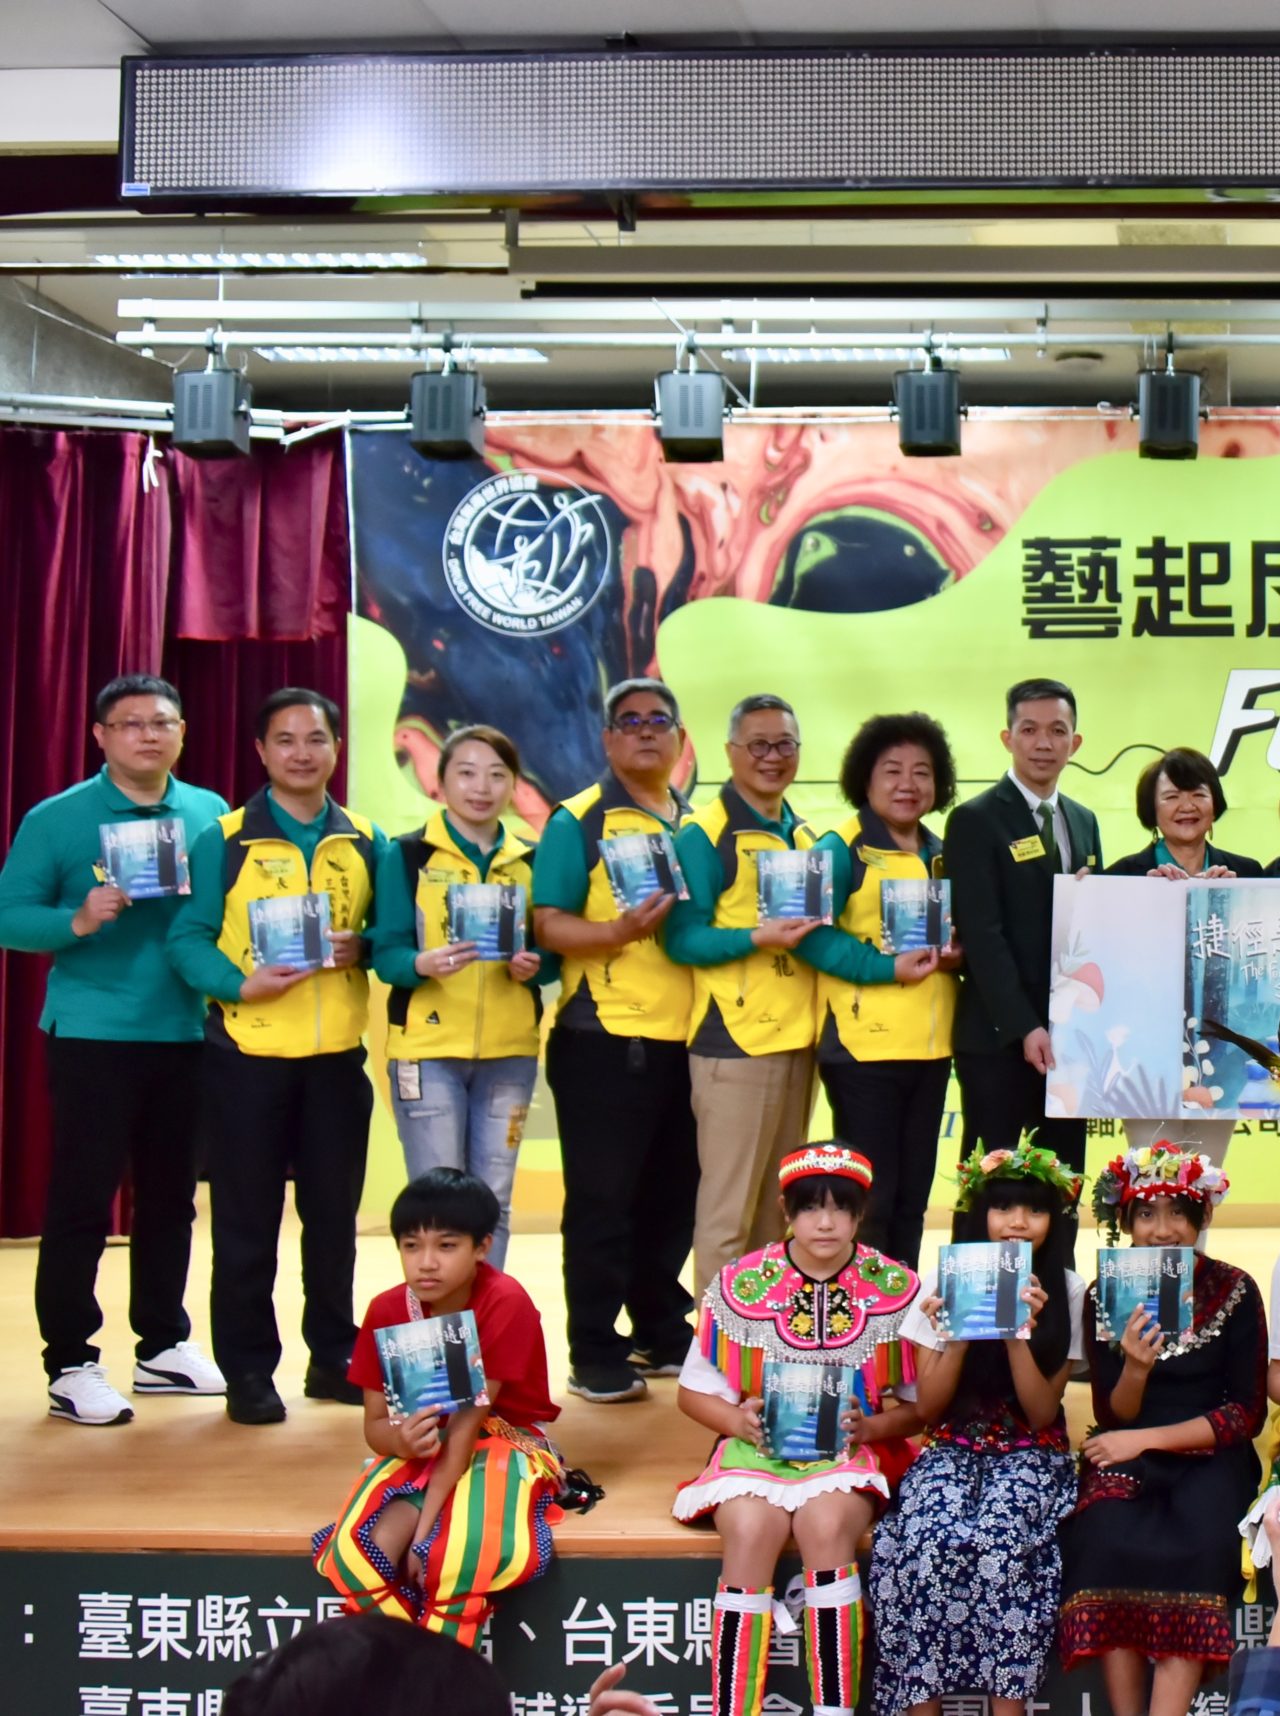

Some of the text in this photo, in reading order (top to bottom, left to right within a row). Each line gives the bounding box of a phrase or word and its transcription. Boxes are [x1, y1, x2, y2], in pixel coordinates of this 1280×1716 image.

[447, 557, 584, 630] DRUG FREE WORLD TAIWAN
[1240, 960, 1265, 986] The
